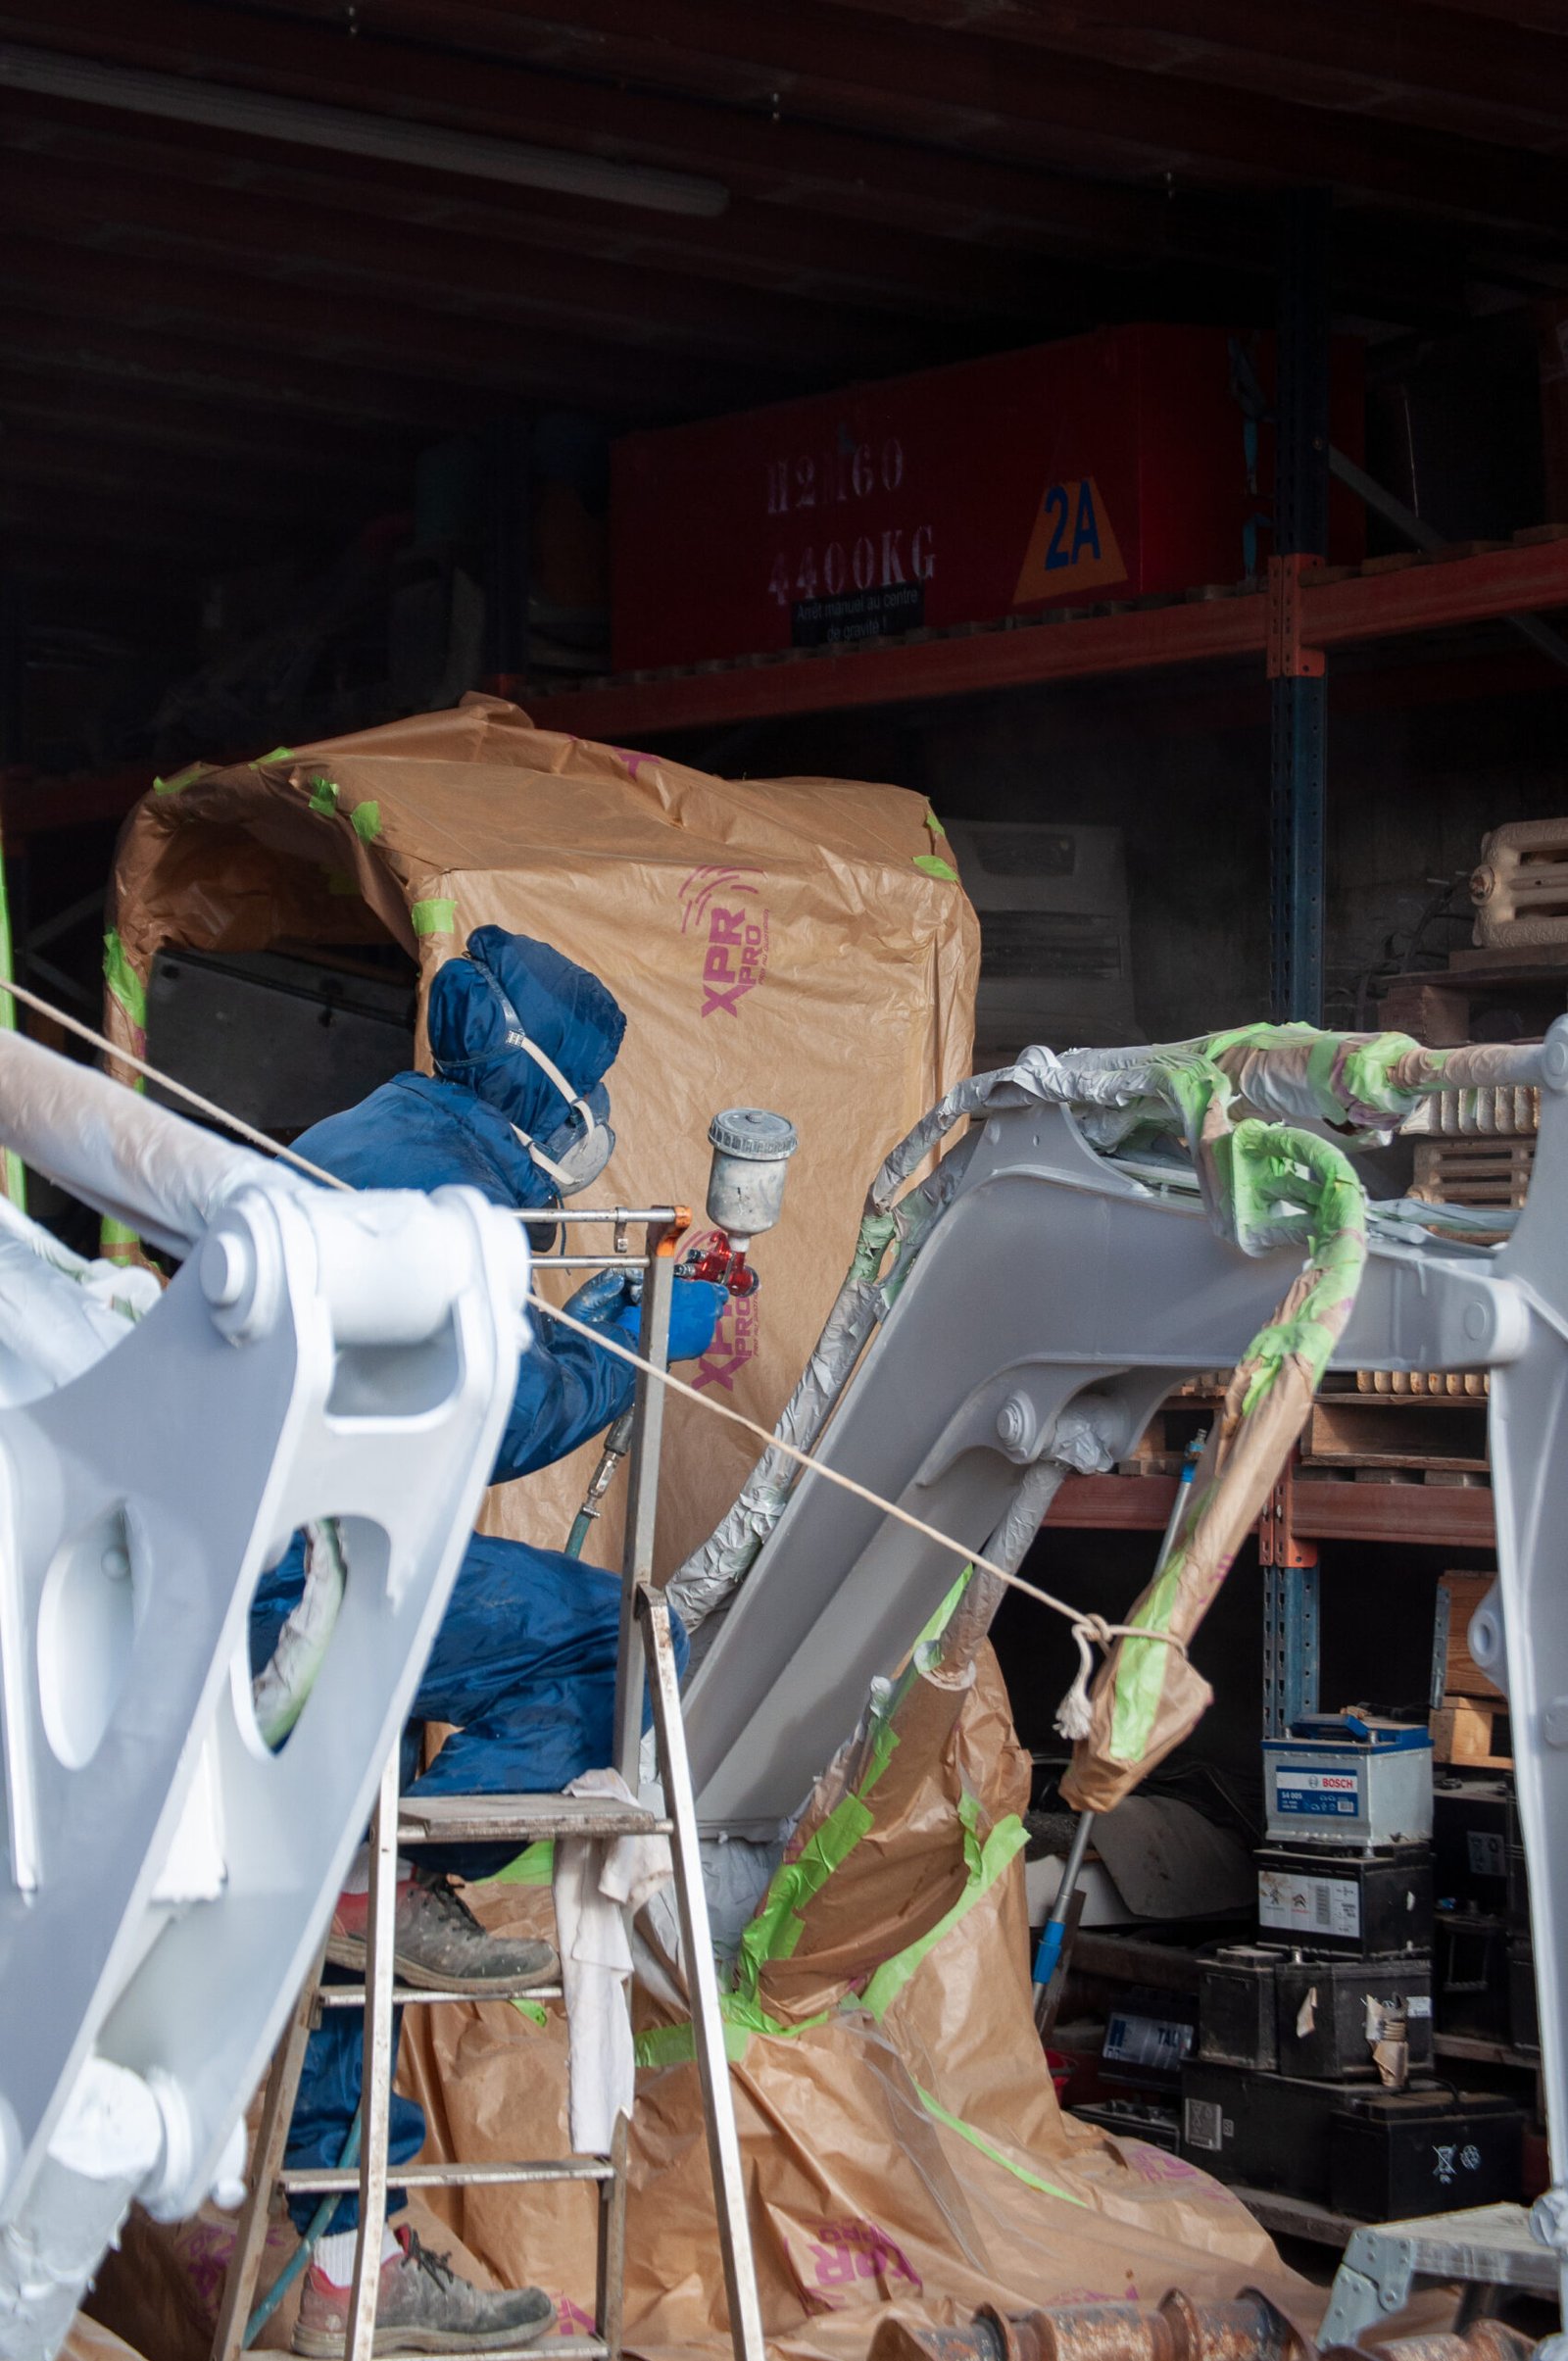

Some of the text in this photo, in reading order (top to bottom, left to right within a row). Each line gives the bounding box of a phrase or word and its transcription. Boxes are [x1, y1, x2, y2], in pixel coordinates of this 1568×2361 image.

[1045, 480, 1101, 570] 2A
[767, 524, 938, 606] 4400KG
[797, 588, 918, 620] Arrêt manuel au centre
[827, 625, 840, 643] de
[844, 618, 879, 643] gravité
[702, 908, 755, 1018] XPR
[738, 924, 762, 986] PRO
[735, 1298, 753, 1357] PRO
[1322, 1778, 1352, 1789] BOSCH
